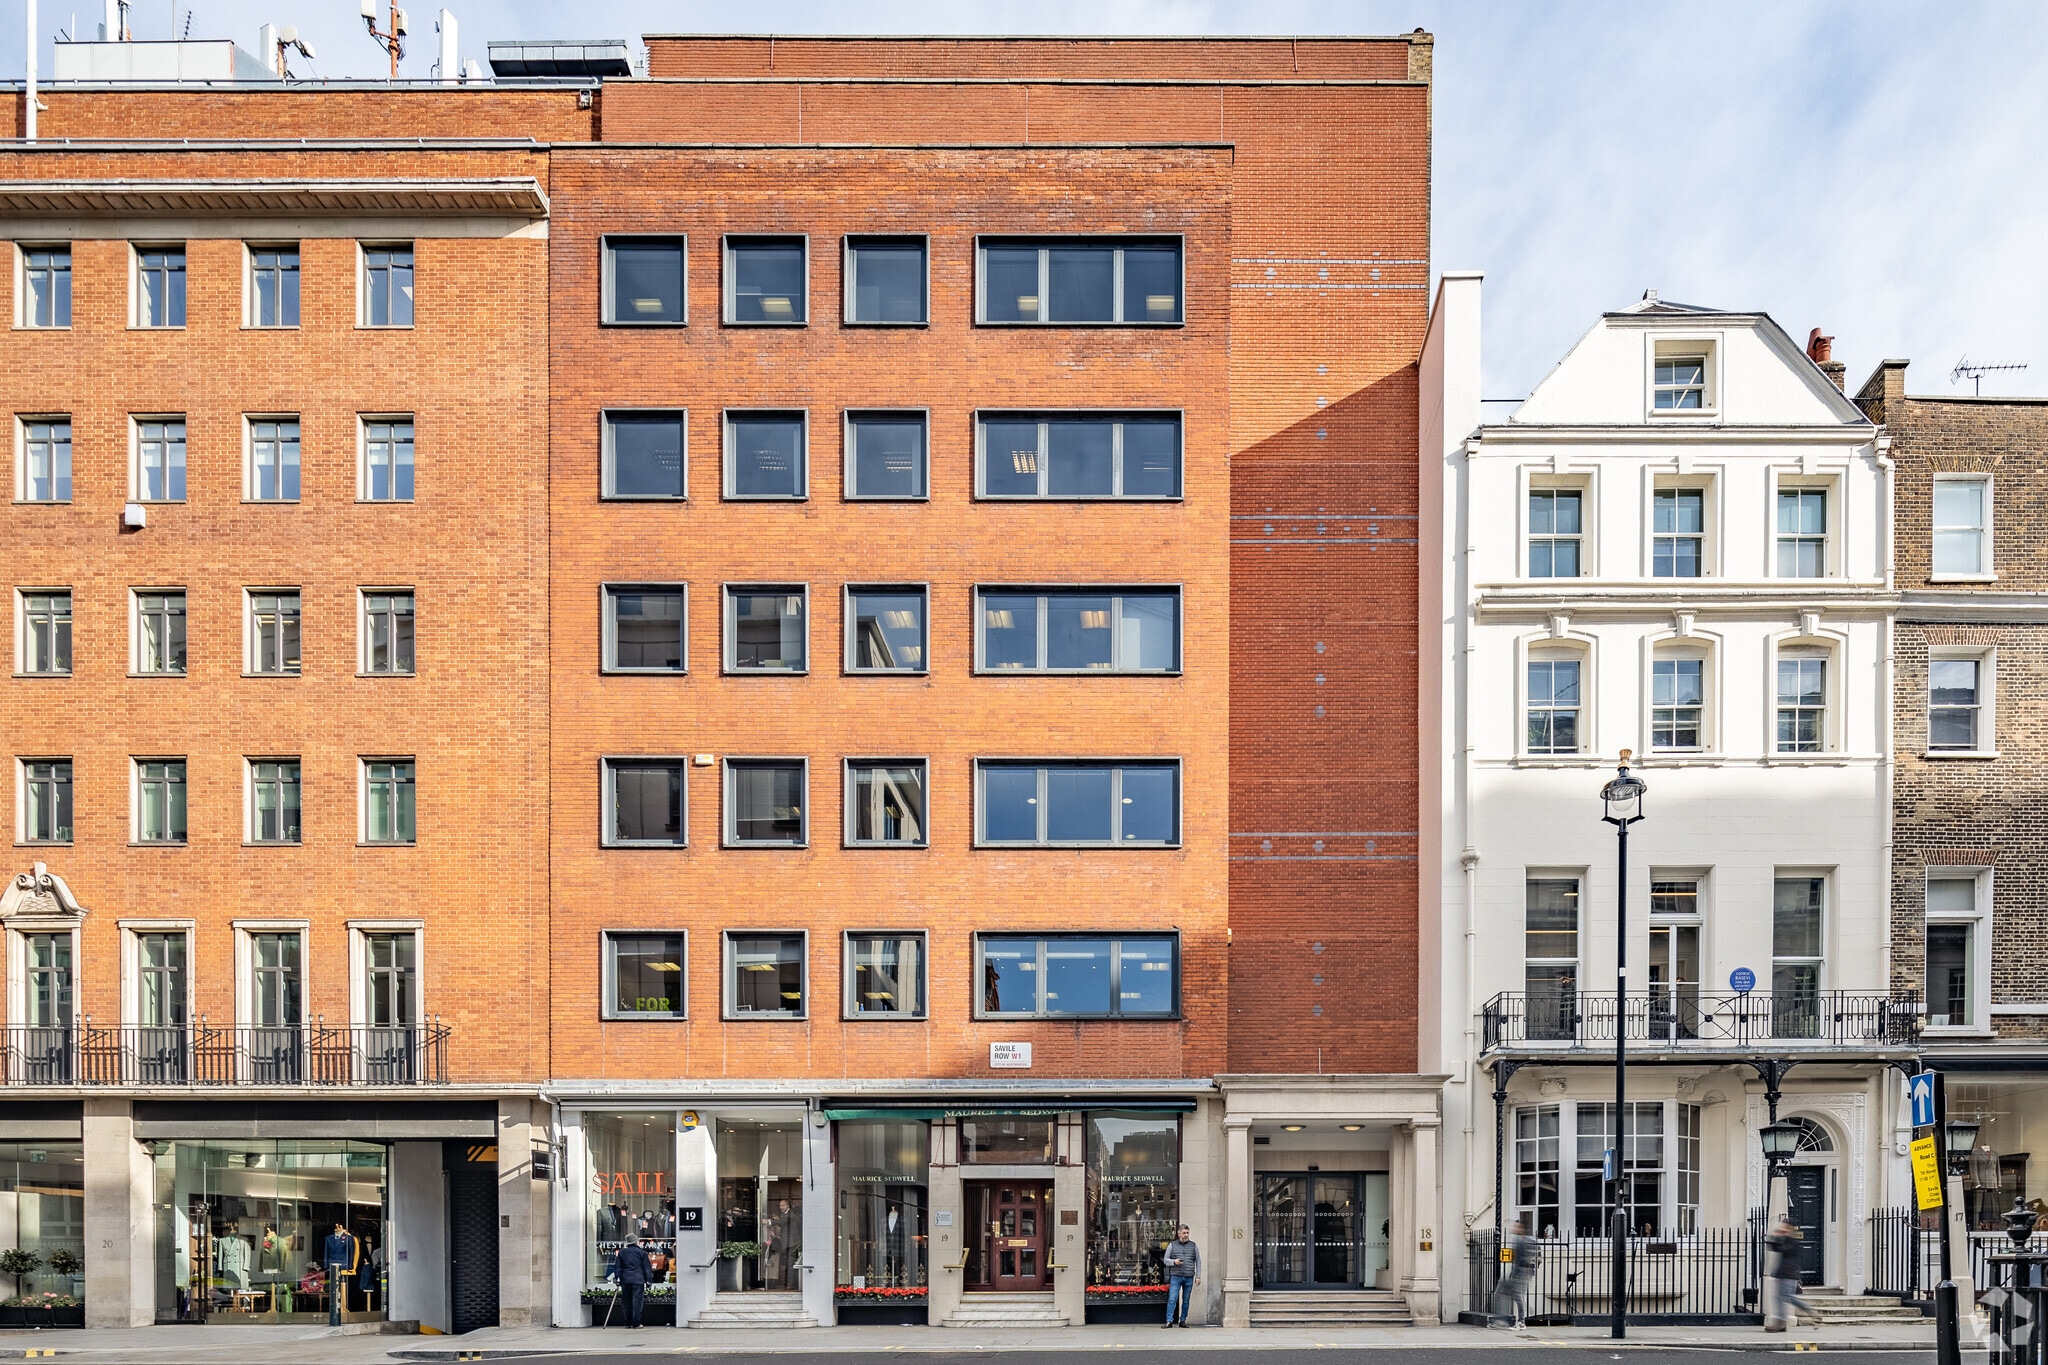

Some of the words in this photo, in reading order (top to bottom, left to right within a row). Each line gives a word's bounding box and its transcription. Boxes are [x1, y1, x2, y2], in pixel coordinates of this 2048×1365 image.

[636, 997, 670, 1011] FOR
[944, 1109, 997, 1117] MAURICE
[1914, 1143, 1932, 1151] ADVANCE
[593, 1171, 673, 1194] SALE
[685, 1211, 696, 1221] 19
[1955, 1212, 1963, 1221] 17
[941, 1234, 949, 1242] 19
[1066, 1234, 1074, 1242] 19
[1232, 1228, 1243, 1240] 18
[1421, 1228, 1432, 1239] 18
[102, 1239, 114, 1249] 20
[595, 1241, 630, 1249] CHESTE
[1502, 1250, 1510, 1260] H
